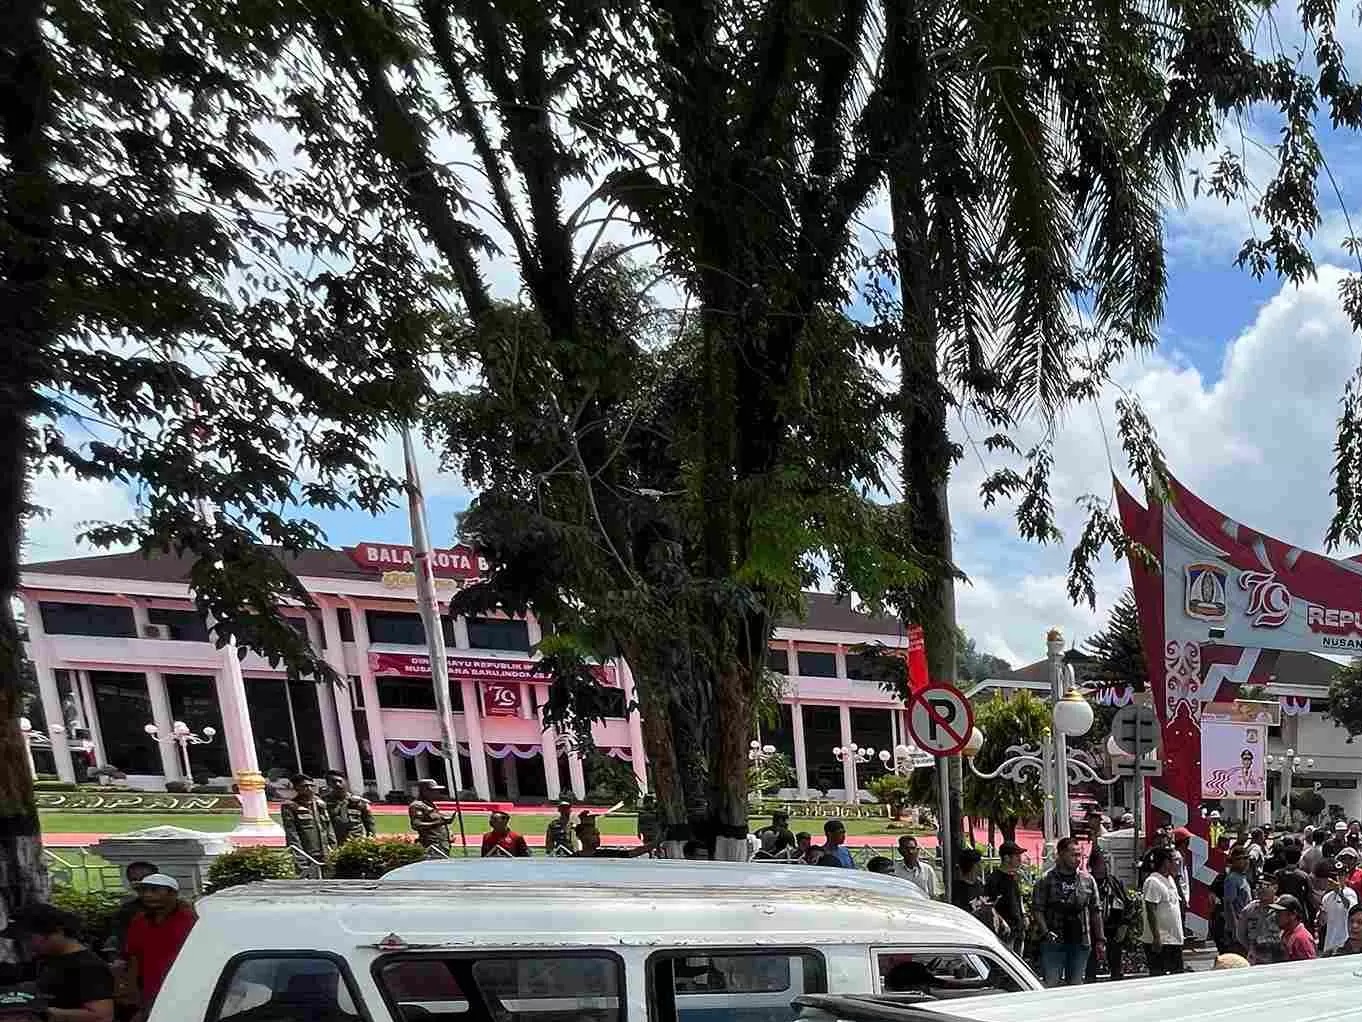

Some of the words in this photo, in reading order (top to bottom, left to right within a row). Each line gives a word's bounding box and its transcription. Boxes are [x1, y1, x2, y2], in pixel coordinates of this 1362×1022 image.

[367, 547, 414, 564] BALA
[1239, 570, 1291, 627] 79
[928, 698, 956, 740] P
